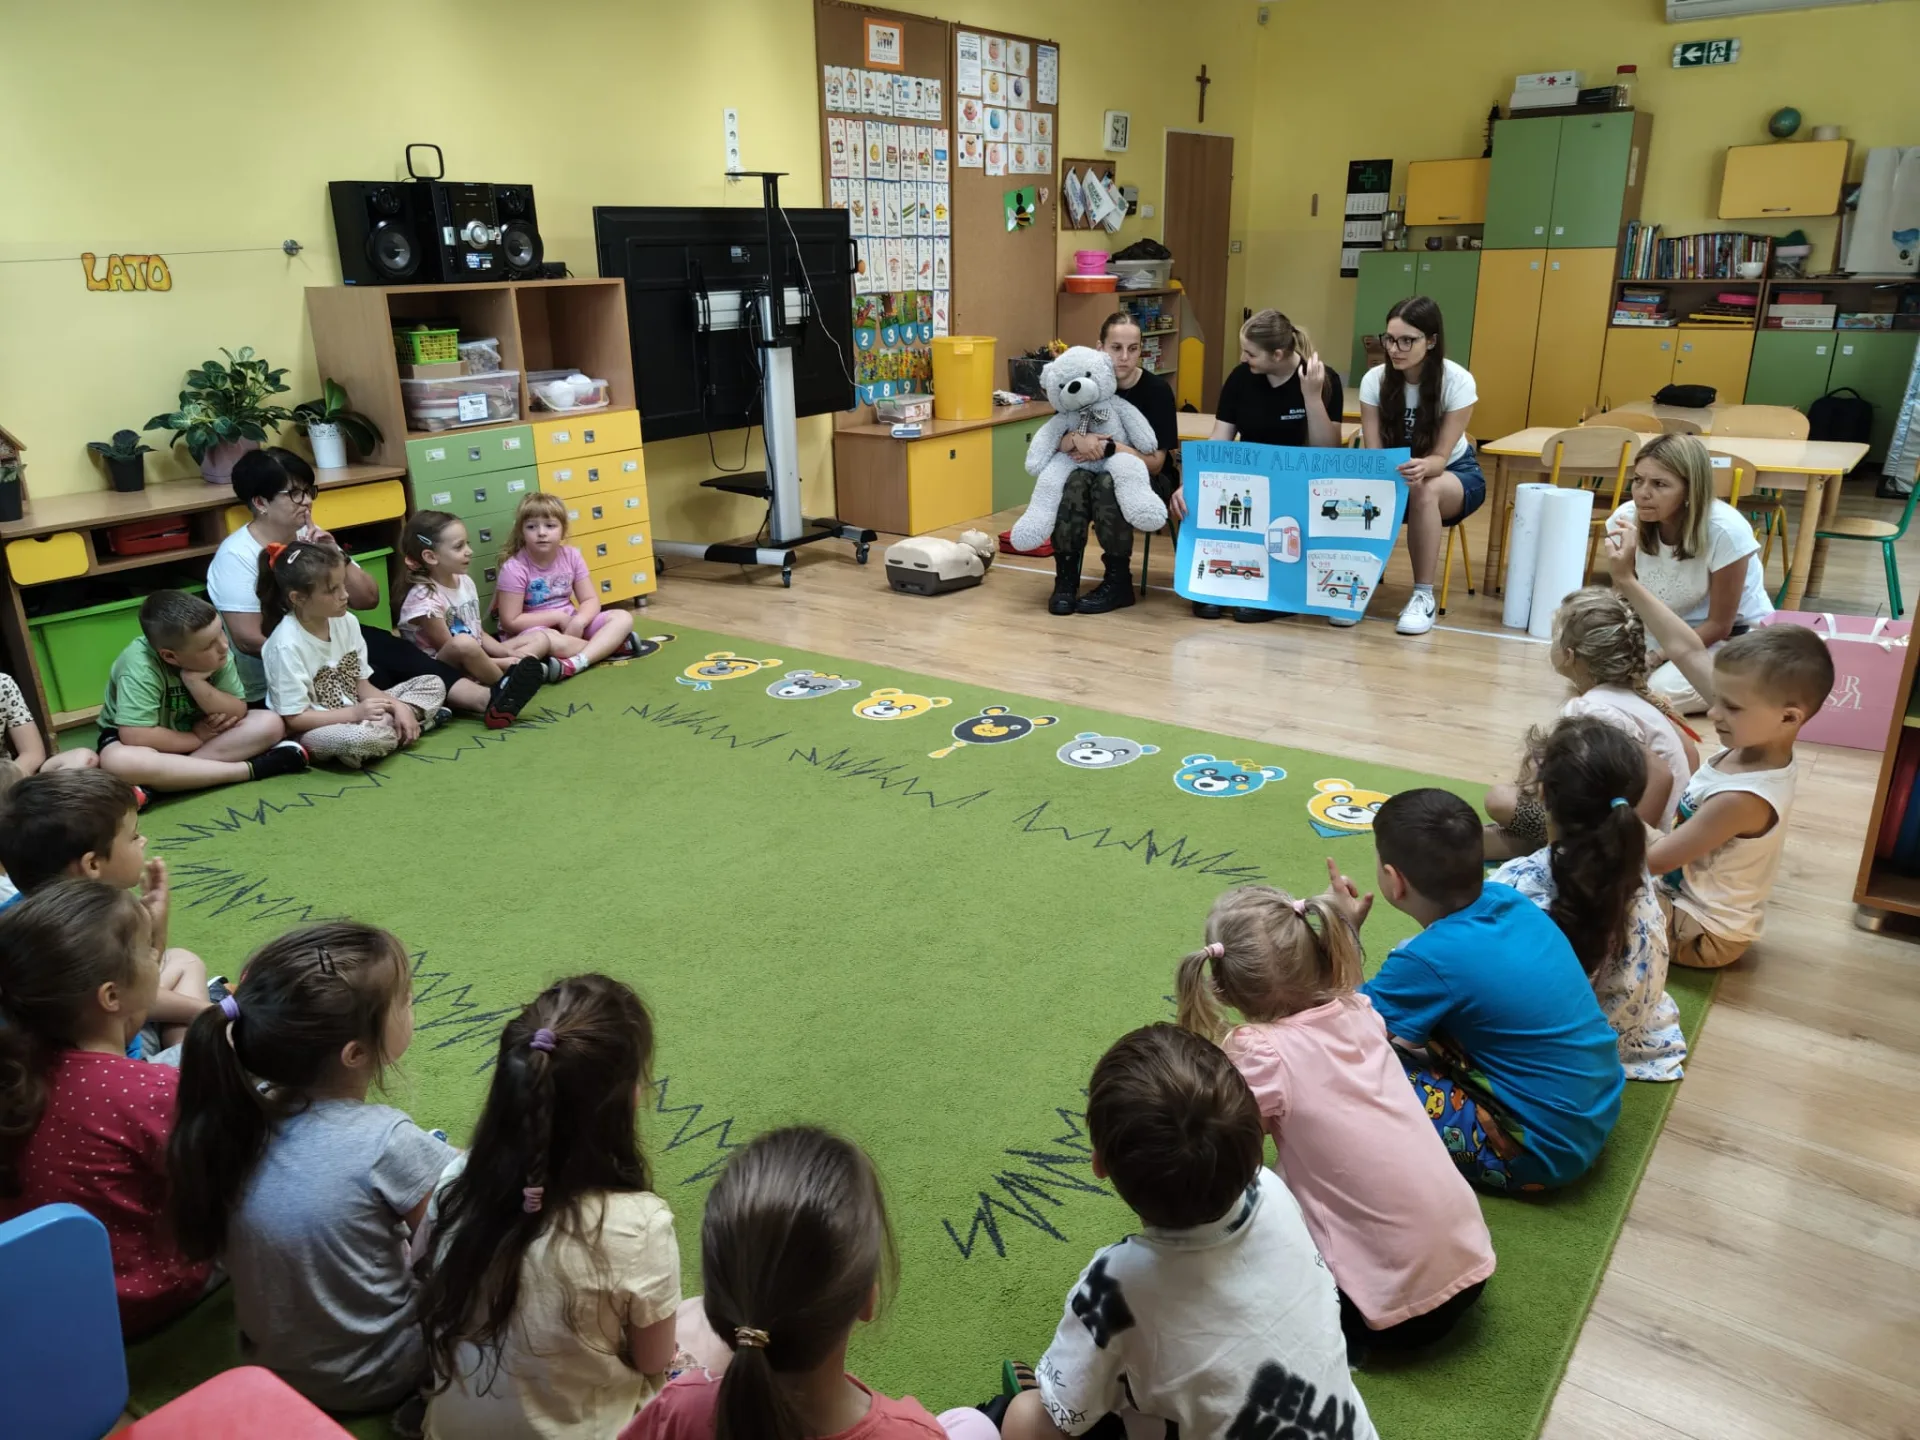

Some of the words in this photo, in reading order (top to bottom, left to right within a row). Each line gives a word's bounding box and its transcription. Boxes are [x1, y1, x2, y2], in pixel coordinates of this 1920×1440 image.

[81, 252, 172, 291] LATO
[861, 332, 868, 346] 2
[888, 329, 895, 342] 3
[906, 326, 913, 339] 4
[923, 326, 930, 339] 5
[867, 385, 874, 400] 7
[883, 383, 890, 396] 8
[904, 381, 911, 393] 9
[1196, 444, 1260, 467] NUMERY
[1270, 452, 1387, 474] ALARMOWE
[1050, 1400, 1088, 1426] PART
